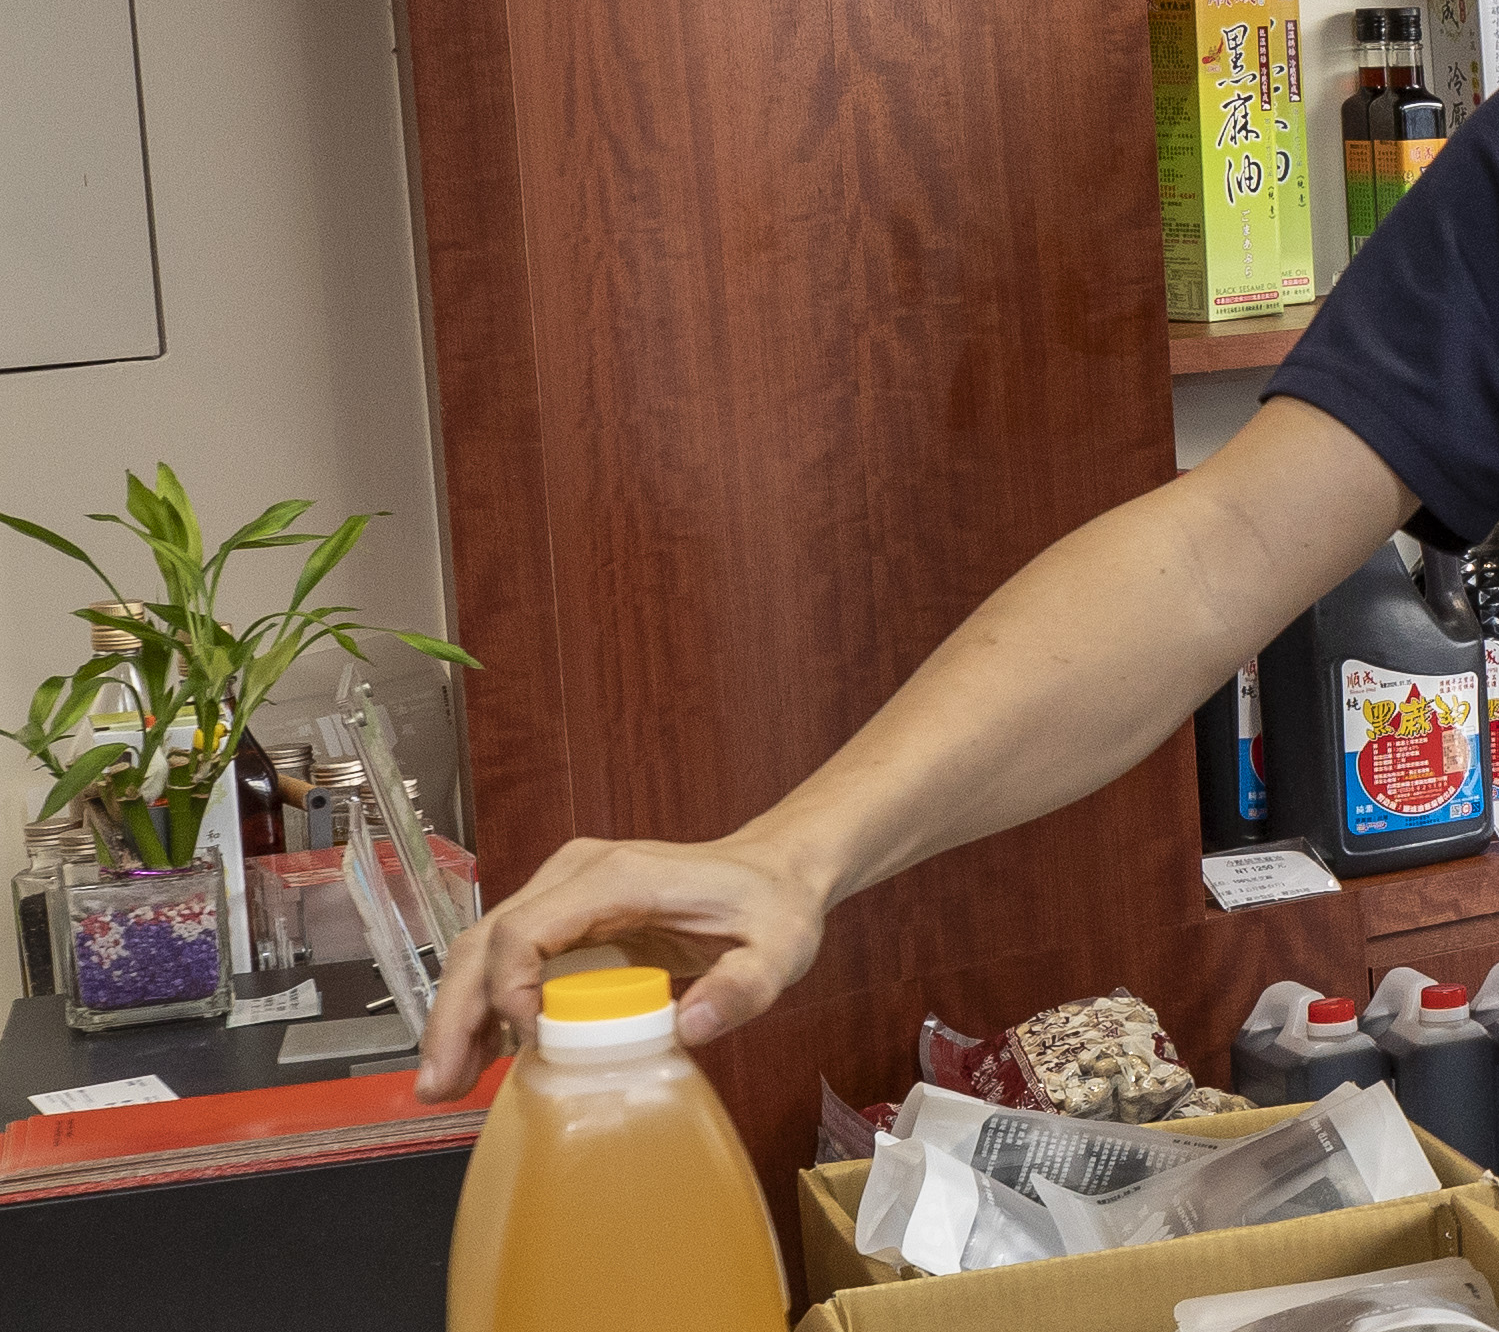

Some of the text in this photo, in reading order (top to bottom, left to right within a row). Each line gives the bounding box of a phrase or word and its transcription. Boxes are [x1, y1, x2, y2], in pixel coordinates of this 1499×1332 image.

[1216, 23, 1263, 206] 黑麻油
[1346, 670, 1378, 689] 順成
[1362, 693, 1471, 740] 黑麻油
